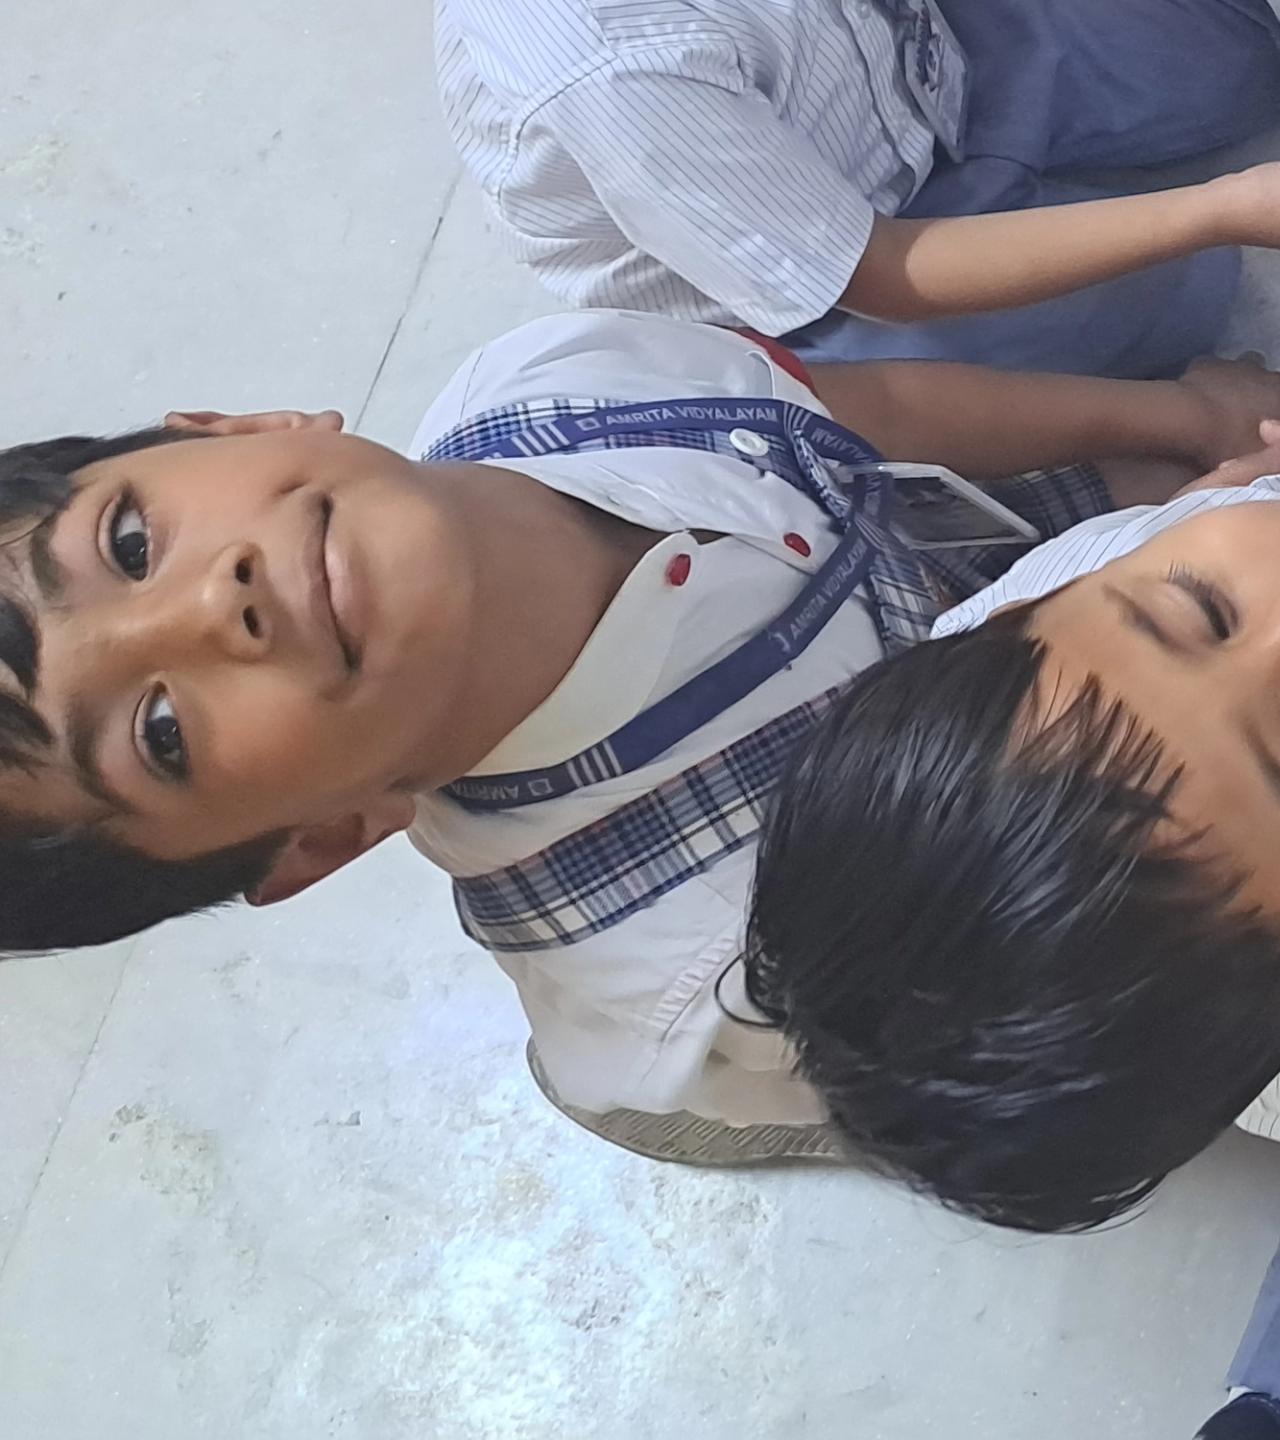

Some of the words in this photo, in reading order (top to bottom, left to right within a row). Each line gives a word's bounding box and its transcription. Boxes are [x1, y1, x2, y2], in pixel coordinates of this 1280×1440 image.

[605, 408, 675, 427] AMRITA
[675, 405, 779, 424] VIDYALAYAM
[790, 593, 827, 641] AMRITA
